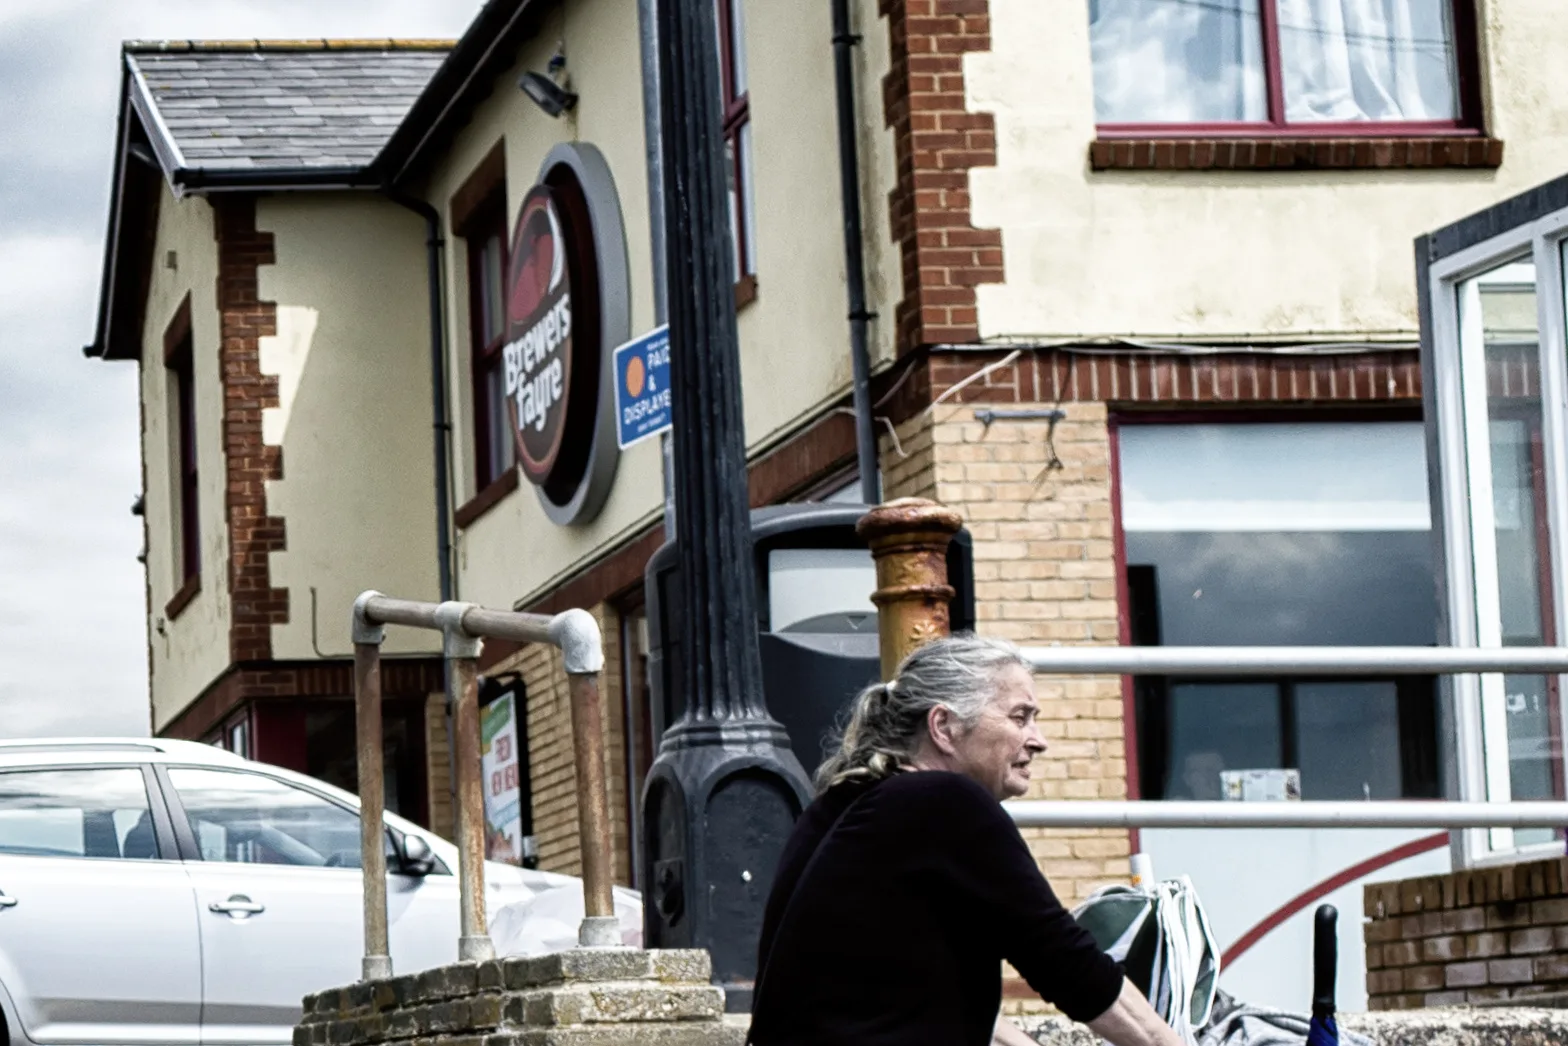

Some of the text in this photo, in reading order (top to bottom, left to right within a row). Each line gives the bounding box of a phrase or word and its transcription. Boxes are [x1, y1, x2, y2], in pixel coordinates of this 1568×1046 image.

[503, 293, 571, 396] Brewers
[516, 358, 562, 432] fayre
[624, 387, 672, 425] DISPLAYE
